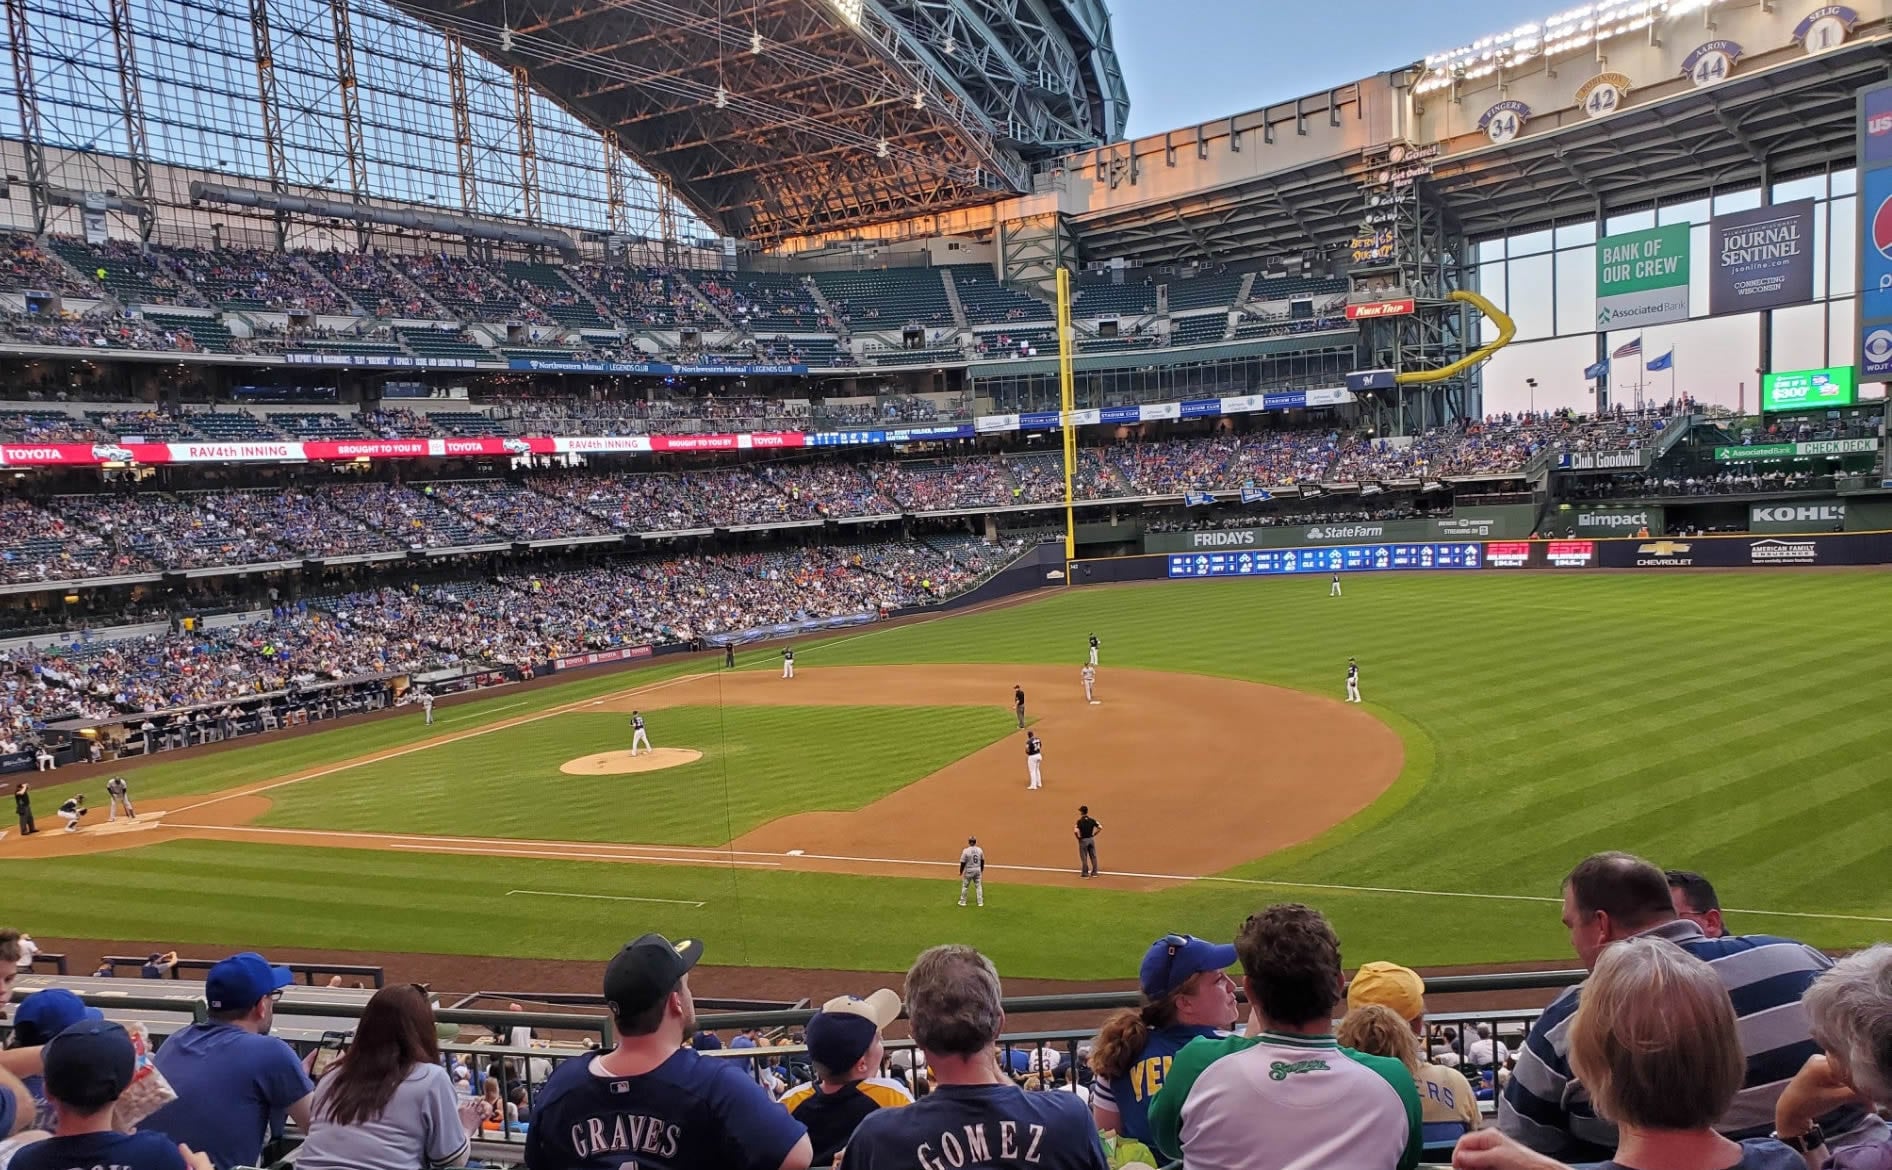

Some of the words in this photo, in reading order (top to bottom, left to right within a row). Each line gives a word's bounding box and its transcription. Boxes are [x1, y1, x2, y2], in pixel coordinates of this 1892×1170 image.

[1809, 6, 1840, 22] SELIG
[1818, 27, 1829, 49] 1
[1695, 41, 1728, 57] AARON
[1696, 57, 1724, 82] 44
[1581, 74, 1624, 95] ROBINSON
[1589, 89, 1615, 111] 42
[1487, 101, 1521, 118] FINGERS
[1492, 115, 1516, 139] 34
[1723, 225, 1801, 253] JOURNAL
[1603, 242, 1640, 265] BANK
[1644, 239, 1662, 257] OF
[1721, 241, 1801, 267] SENTINEL
[1603, 265, 1631, 284] OUR
[1732, 259, 1790, 275] jsonline.com
[1734, 276, 1785, 290] CONNECTING
[1738, 283, 1781, 296] WISCONSIN
[539, 362, 581, 370] Northwestern
[634, 364, 649, 372] CLUB
[681, 365, 724, 373] Northwestern
[1866, 362, 1889, 372] WDJT
[338, 445, 379, 455] BROUGHT
[380, 445, 392, 454] TO
[393, 444, 410, 453] YOU
[411, 443, 422, 453] BY
[447, 442, 483, 452] TOYOTA
[568, 440, 603, 450] RAV4th
[605, 439, 639, 449] INNING
[668, 439, 698, 448] BROUGHT
[709, 438, 722, 447] YOU
[723, 438, 732, 446] BY
[752, 437, 783, 446] TOYOTA
[1805, 442, 1841, 454] CHECK
[1843, 439, 1872, 452] DECK
[6, 449, 63, 460] TOYOTA
[189, 447, 237, 458] RAV4th
[240, 446, 288, 457] INNING
[1572, 453, 1594, 470] Club
[1596, 449, 1641, 469] Goodwill
[1590, 511, 1648, 528] impact
[1193, 531, 1254, 547] FRIDAYS
[1636, 558, 1693, 566] CHEVROLET
[973, 854, 979, 864] 6
[571, 1113, 681, 1159] GRAVES
[917, 1120, 1045, 1170] GOMEZ
